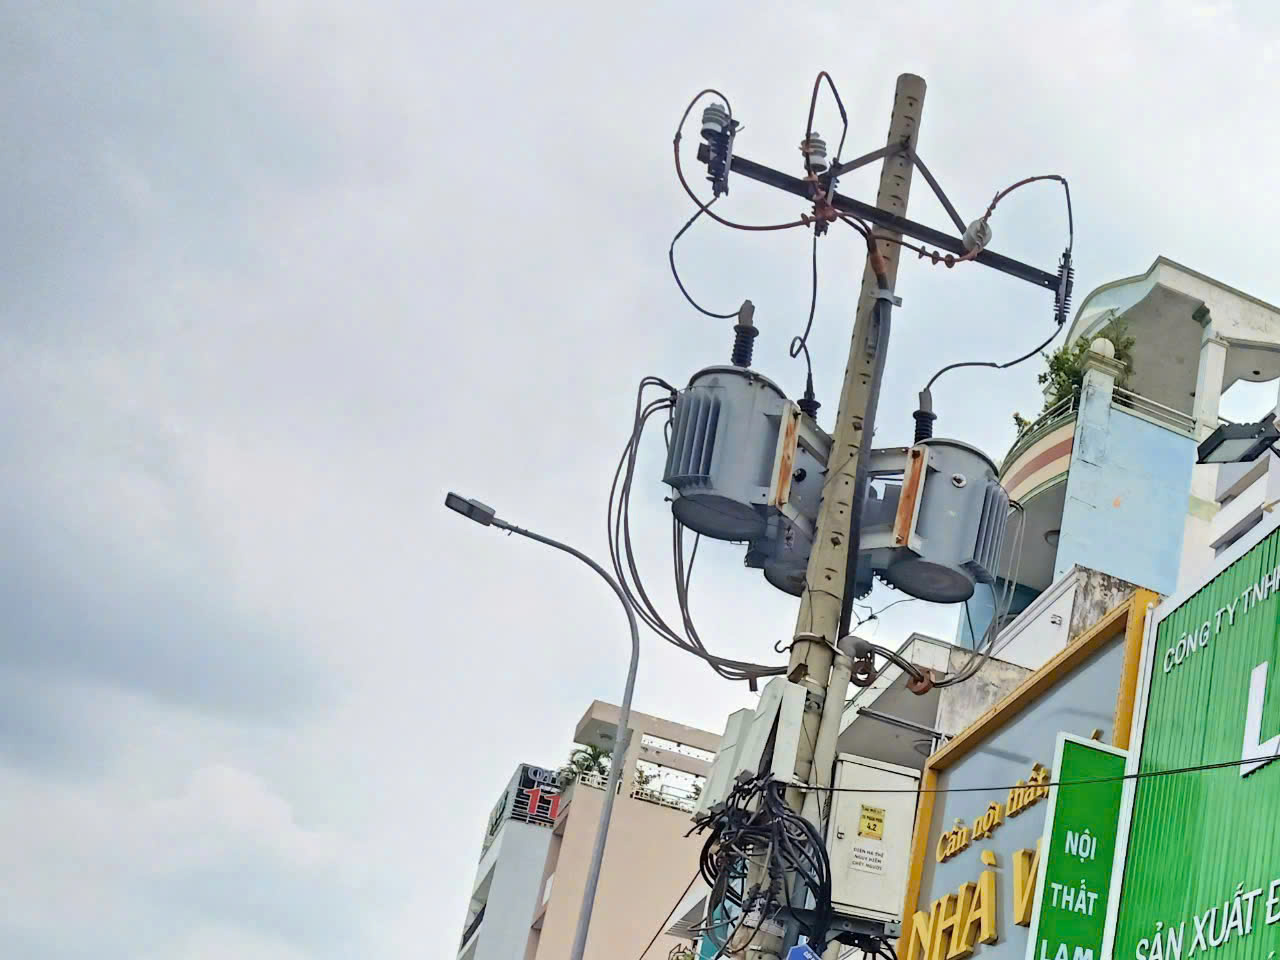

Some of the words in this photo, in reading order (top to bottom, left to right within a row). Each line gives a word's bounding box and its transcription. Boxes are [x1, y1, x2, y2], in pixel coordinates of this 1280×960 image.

[1163, 621, 1211, 673] CÔNG
[1215, 597, 1240, 634] TY
[972, 800, 1003, 840] nội
[1064, 828, 1098, 863] NỘI
[1051, 879, 1098, 916] THẤT
[1188, 882, 1263, 958] XUẤT
